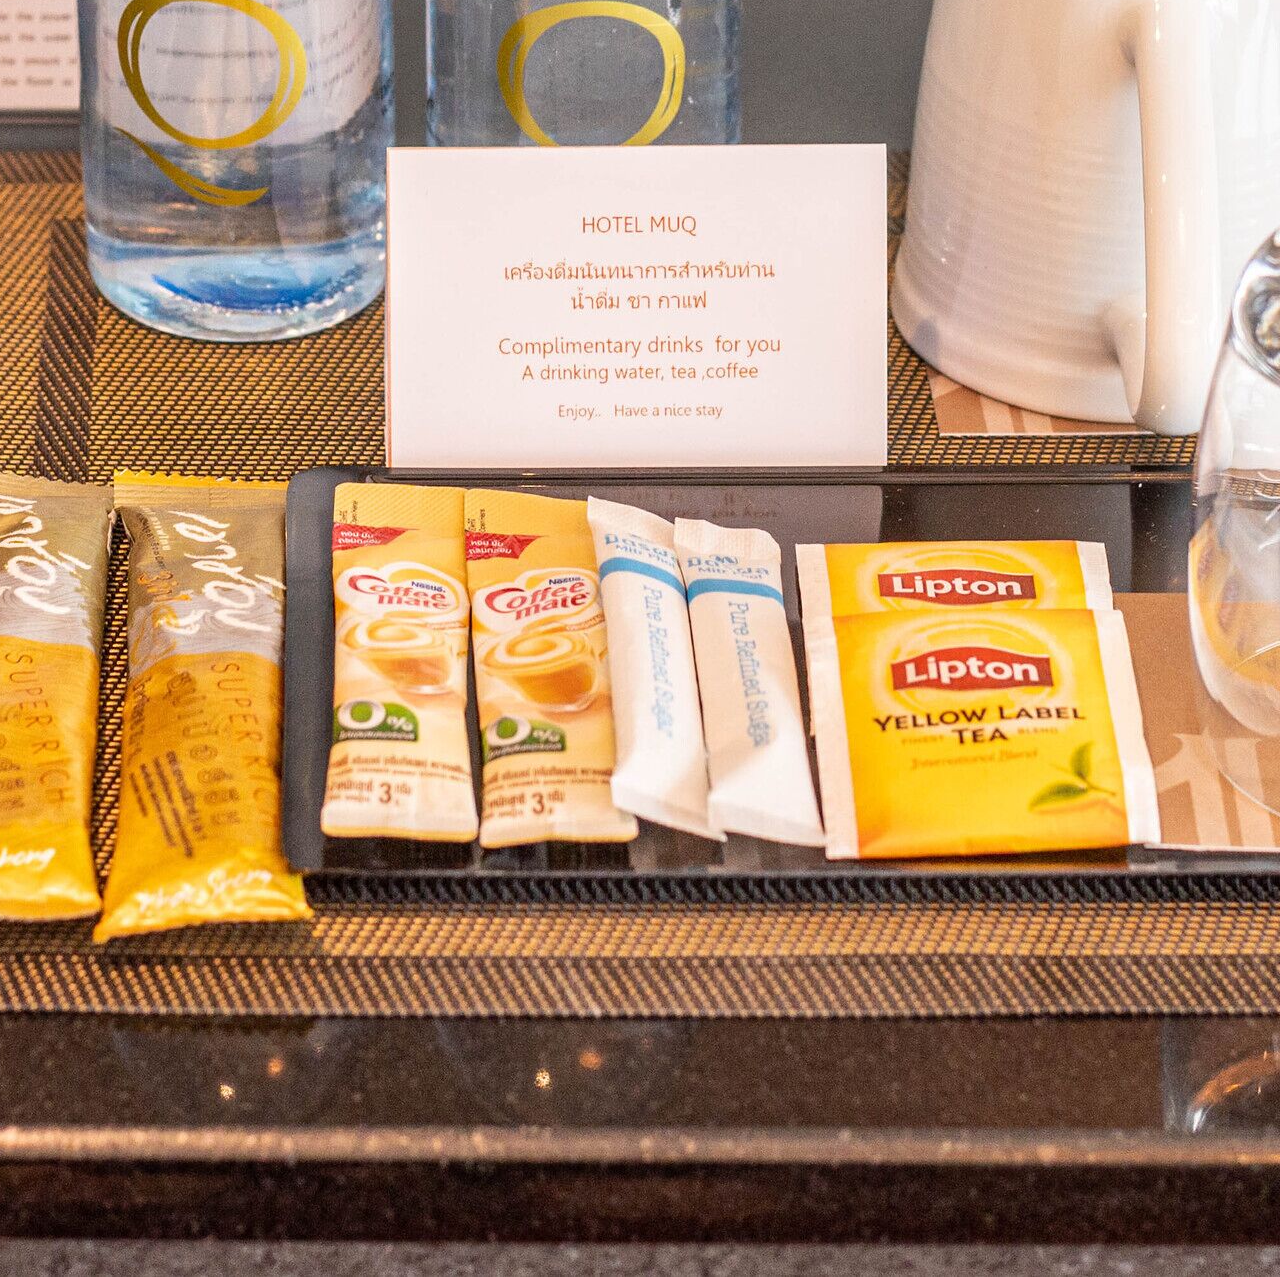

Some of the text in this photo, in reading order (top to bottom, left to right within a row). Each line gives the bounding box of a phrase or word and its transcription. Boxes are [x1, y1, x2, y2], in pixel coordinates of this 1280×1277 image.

[582, 216, 696, 237] HOTEL MUQ
[627, 294, 651, 310] ชา
[659, 290, 707, 309] กาแฟ
[498, 335, 781, 360] Complimentary drinks for you
[522, 365, 534, 381] A
[540, 364, 609, 385] drinking
[615, 366, 664, 382] water,
[671, 366, 697, 380] tea
[614, 404, 648, 417] Have
[652, 407, 660, 417] a
[664, 404, 692, 417] nice
[695, 405, 723, 420] stay
[347, 574, 447, 603] Coffee
[484, 581, 586, 614] Coffee
[892, 574, 1023, 599] Lipton
[377, 594, 448, 610] mate
[514, 594, 587, 621] mate
[727, 600, 750, 636] Pure
[905, 656, 1041, 685] Lipton
[4, 652, 53, 729] SUPER
[210, 661, 263, 744] SUPER
[873, 706, 1087, 733] YELLOW LABEL
[951, 727, 1009, 745] TEA
[379, 782, 392, 804] 3
[532, 792, 546, 815] 3
